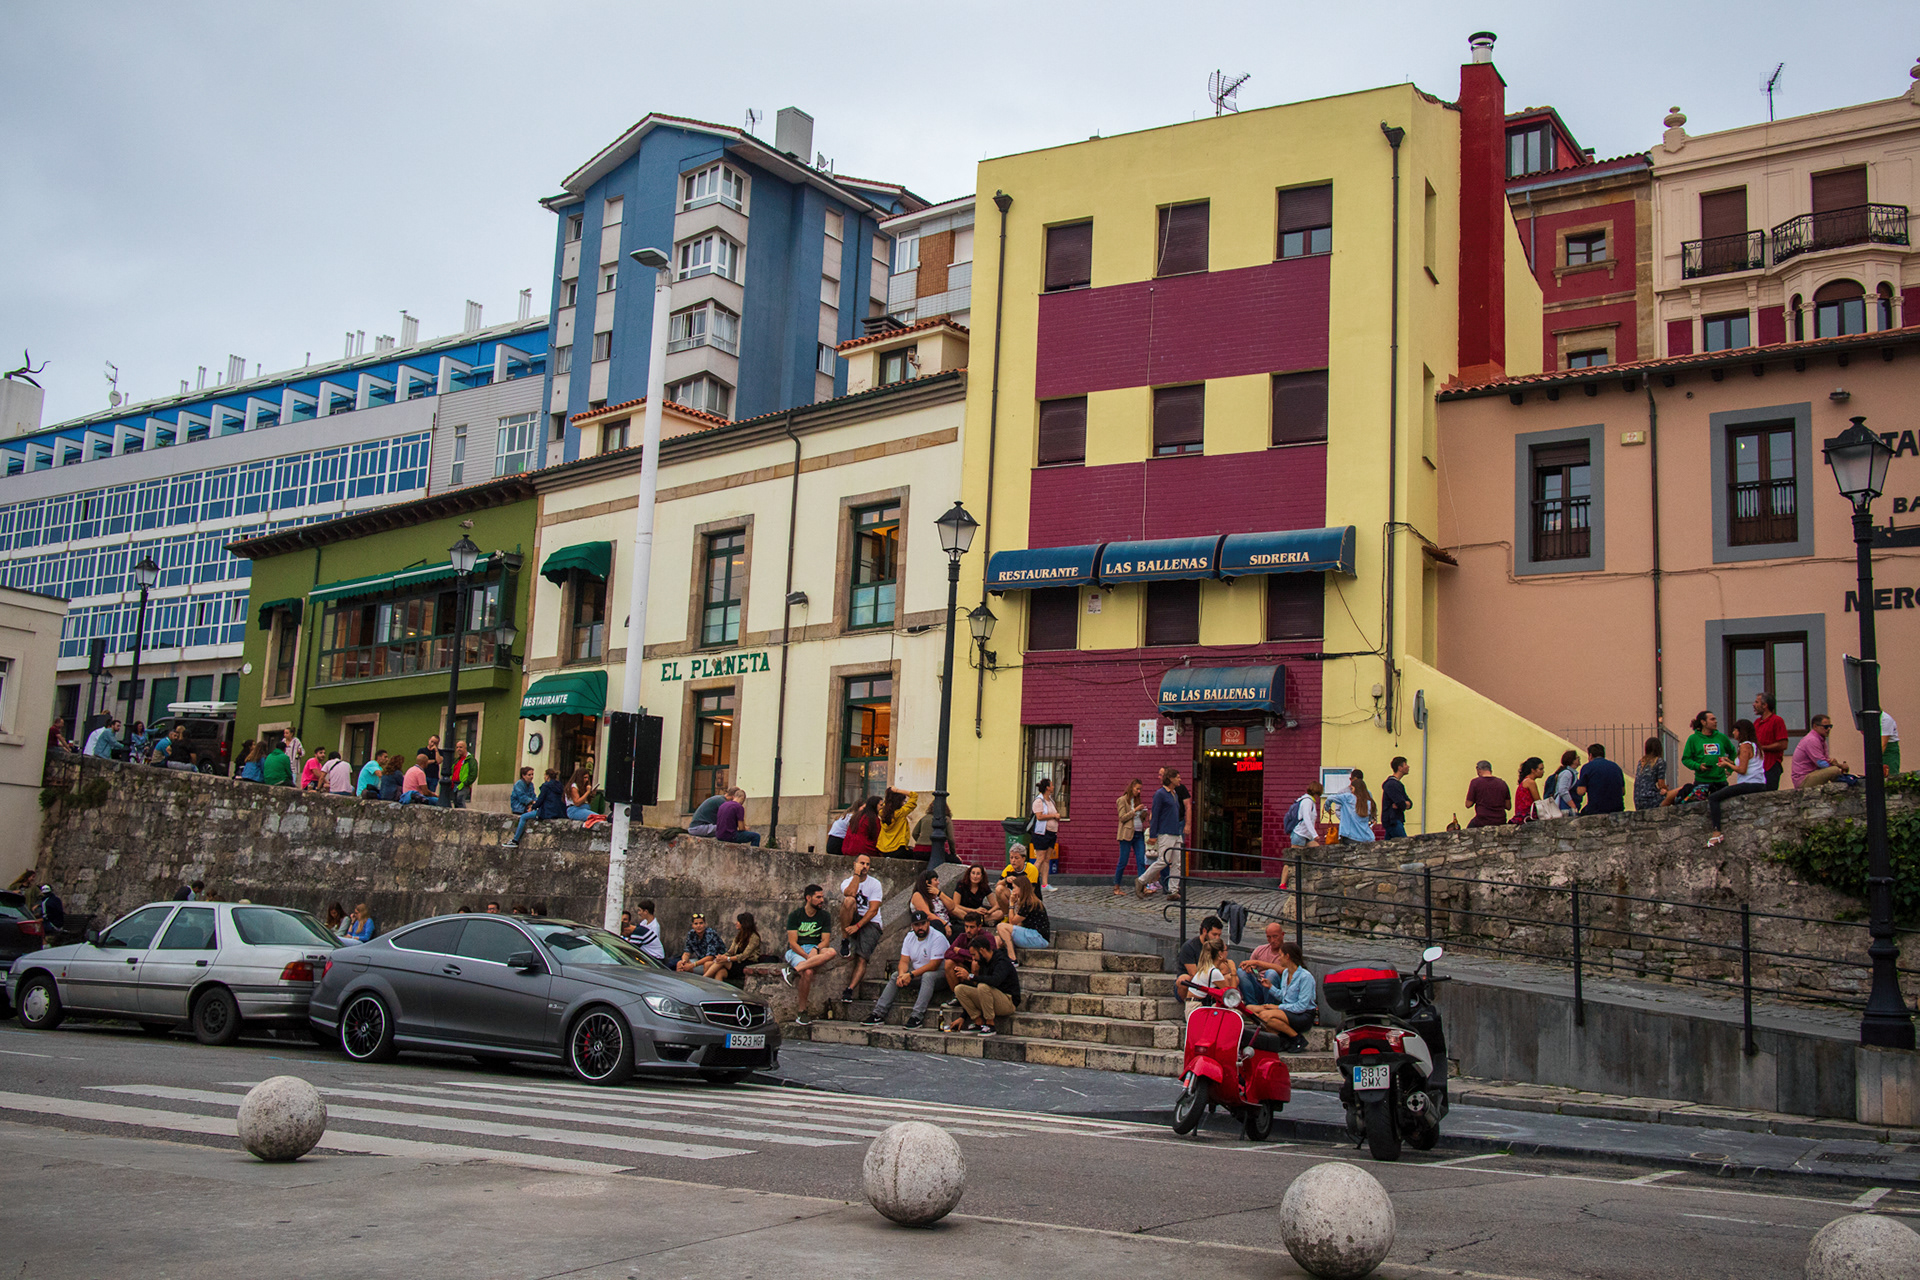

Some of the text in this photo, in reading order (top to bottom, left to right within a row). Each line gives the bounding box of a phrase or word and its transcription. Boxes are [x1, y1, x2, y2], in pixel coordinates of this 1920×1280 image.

[1105, 557, 1208, 575] LAS BALLENAS
[1249, 551, 1310, 566] SIDRERIA
[998, 566, 1079, 581] RESTAURANTE
[661, 652, 770, 681] EL PLANETA
[523, 694, 568, 707] RESTAURANTE
[1162, 691, 1178, 702] Rte
[1180, 689, 1201, 702] LAS
[1203, 687, 1256, 700] BALLENAS
[731, 1035, 752, 1047] 9523
[1361, 1067, 1388, 1077] 6813
[1361, 1077, 1381, 1088] GMX
